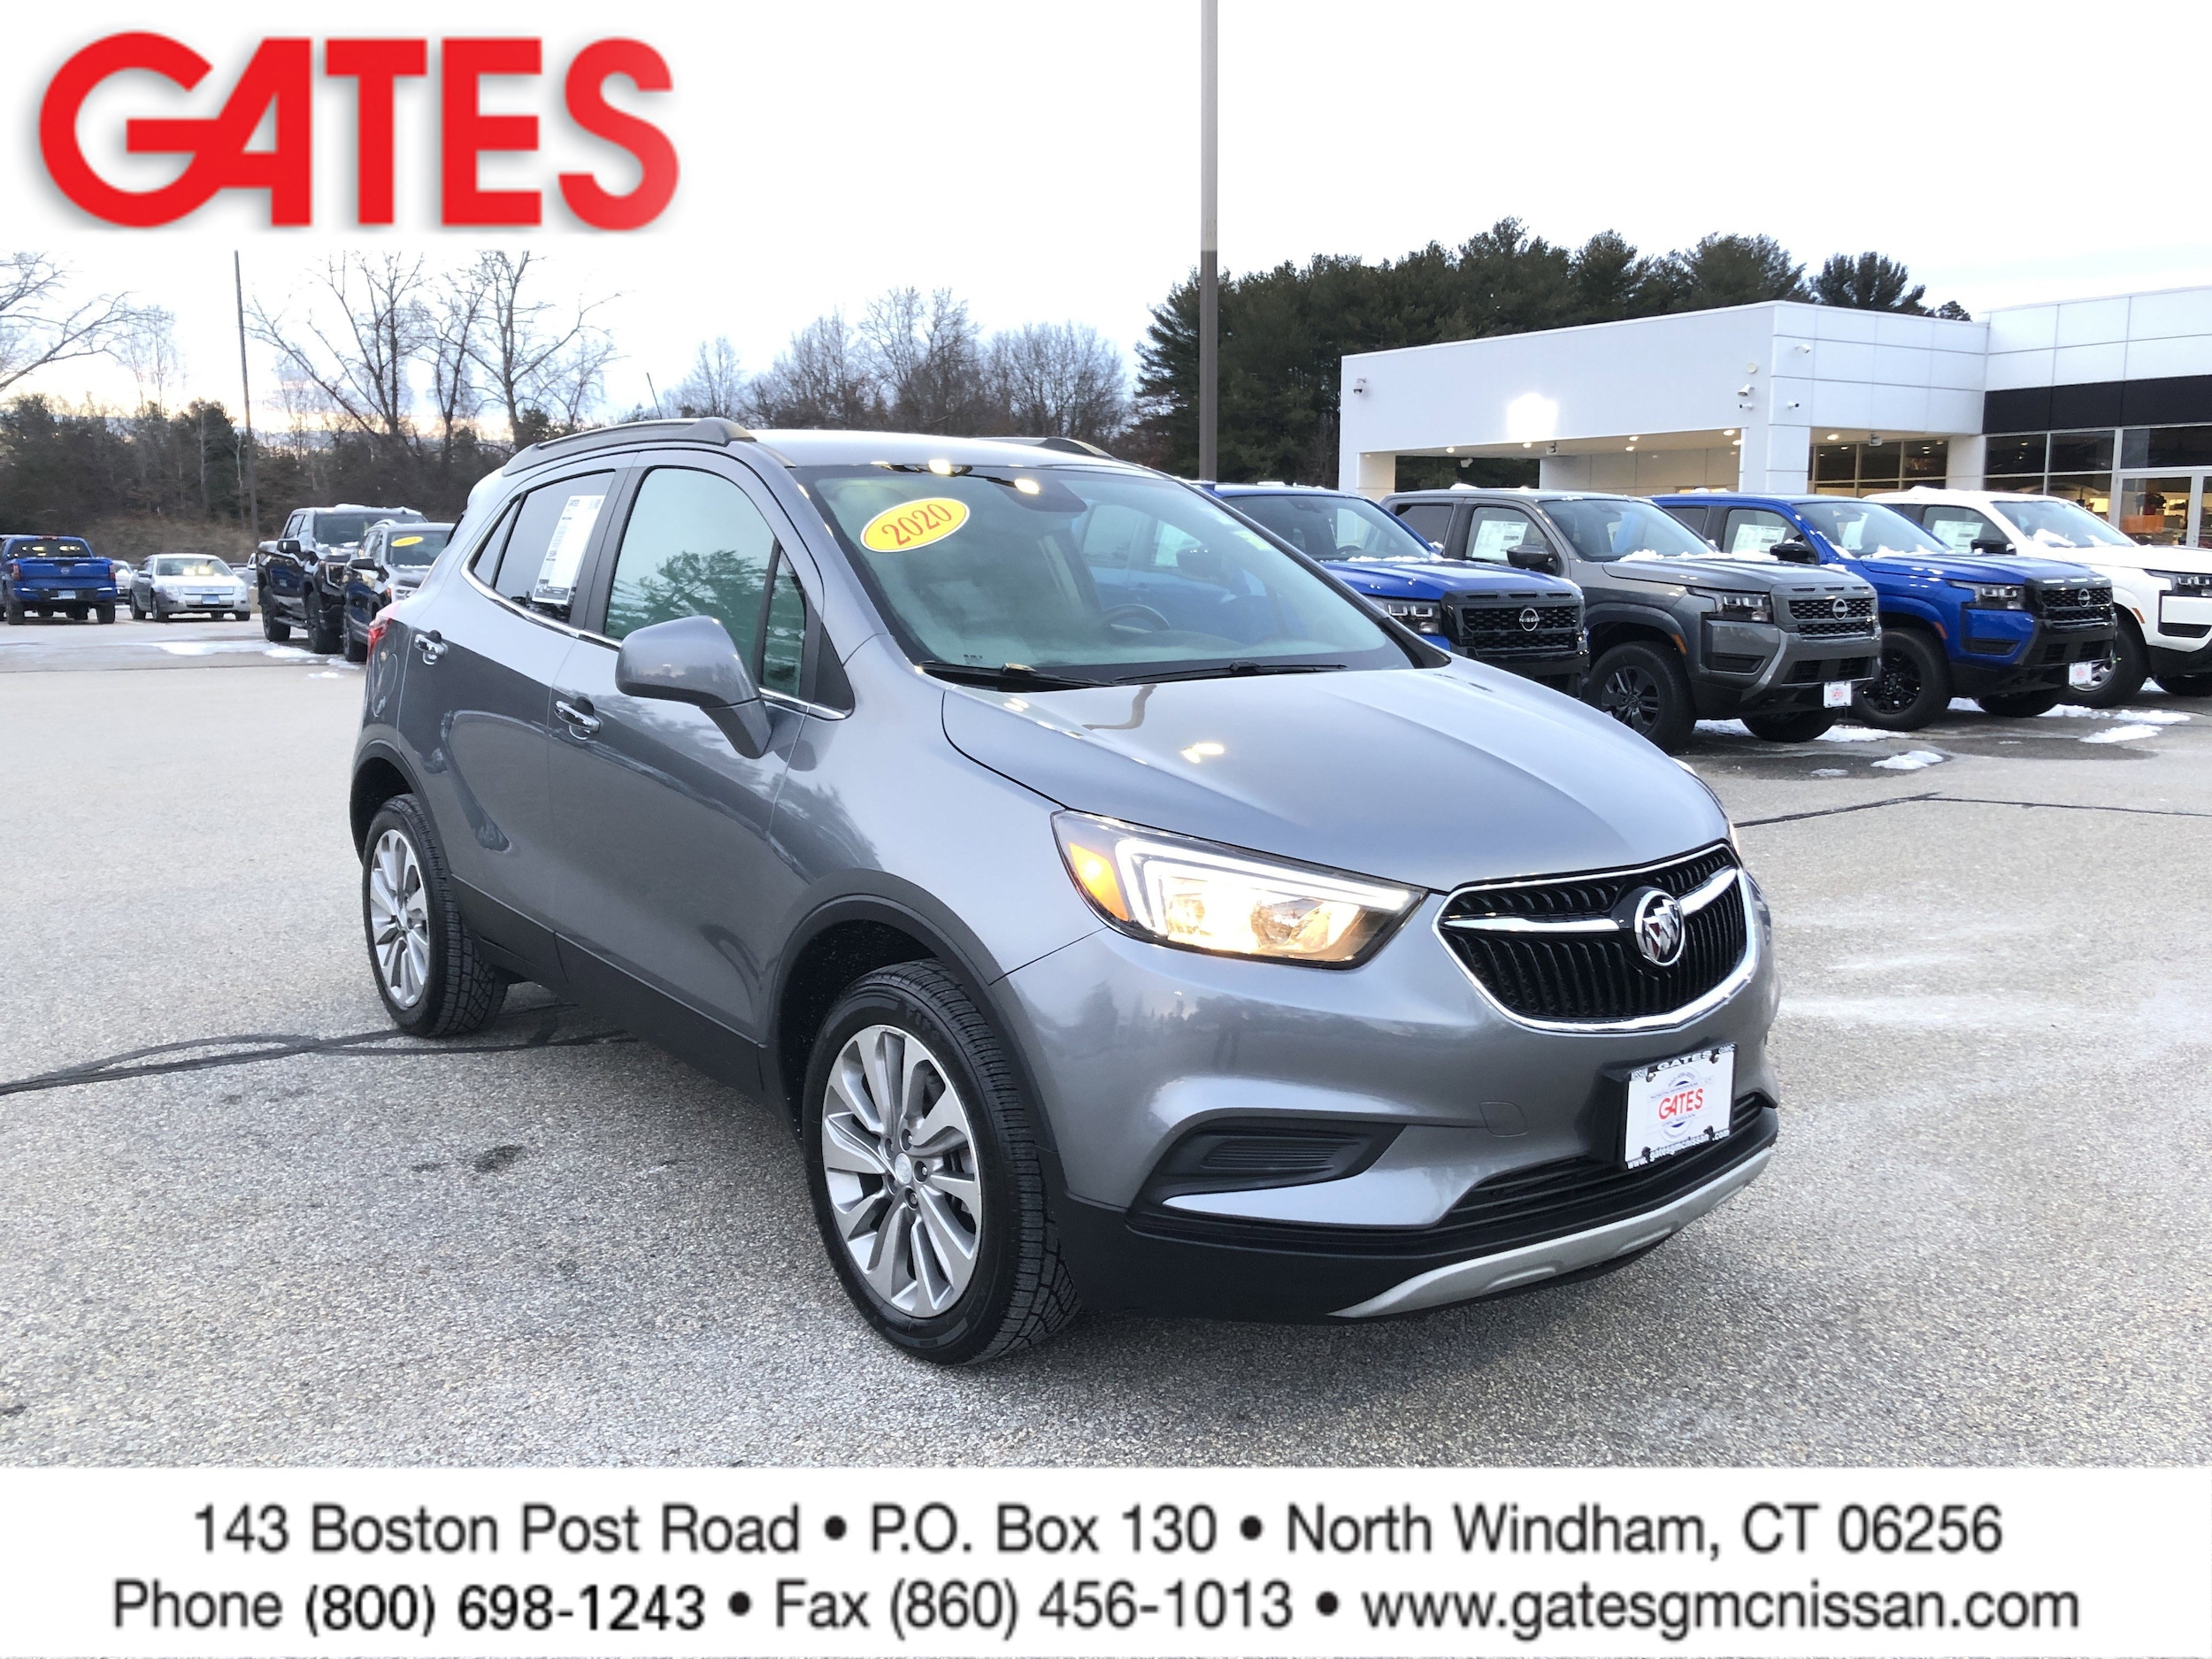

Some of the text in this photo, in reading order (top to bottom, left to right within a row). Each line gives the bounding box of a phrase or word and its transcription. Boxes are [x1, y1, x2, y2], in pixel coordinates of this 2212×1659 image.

[881, 503, 952, 546] 2020
[1656, 1049, 1713, 1071] GATES
[1658, 1087, 1704, 1120] GATES
